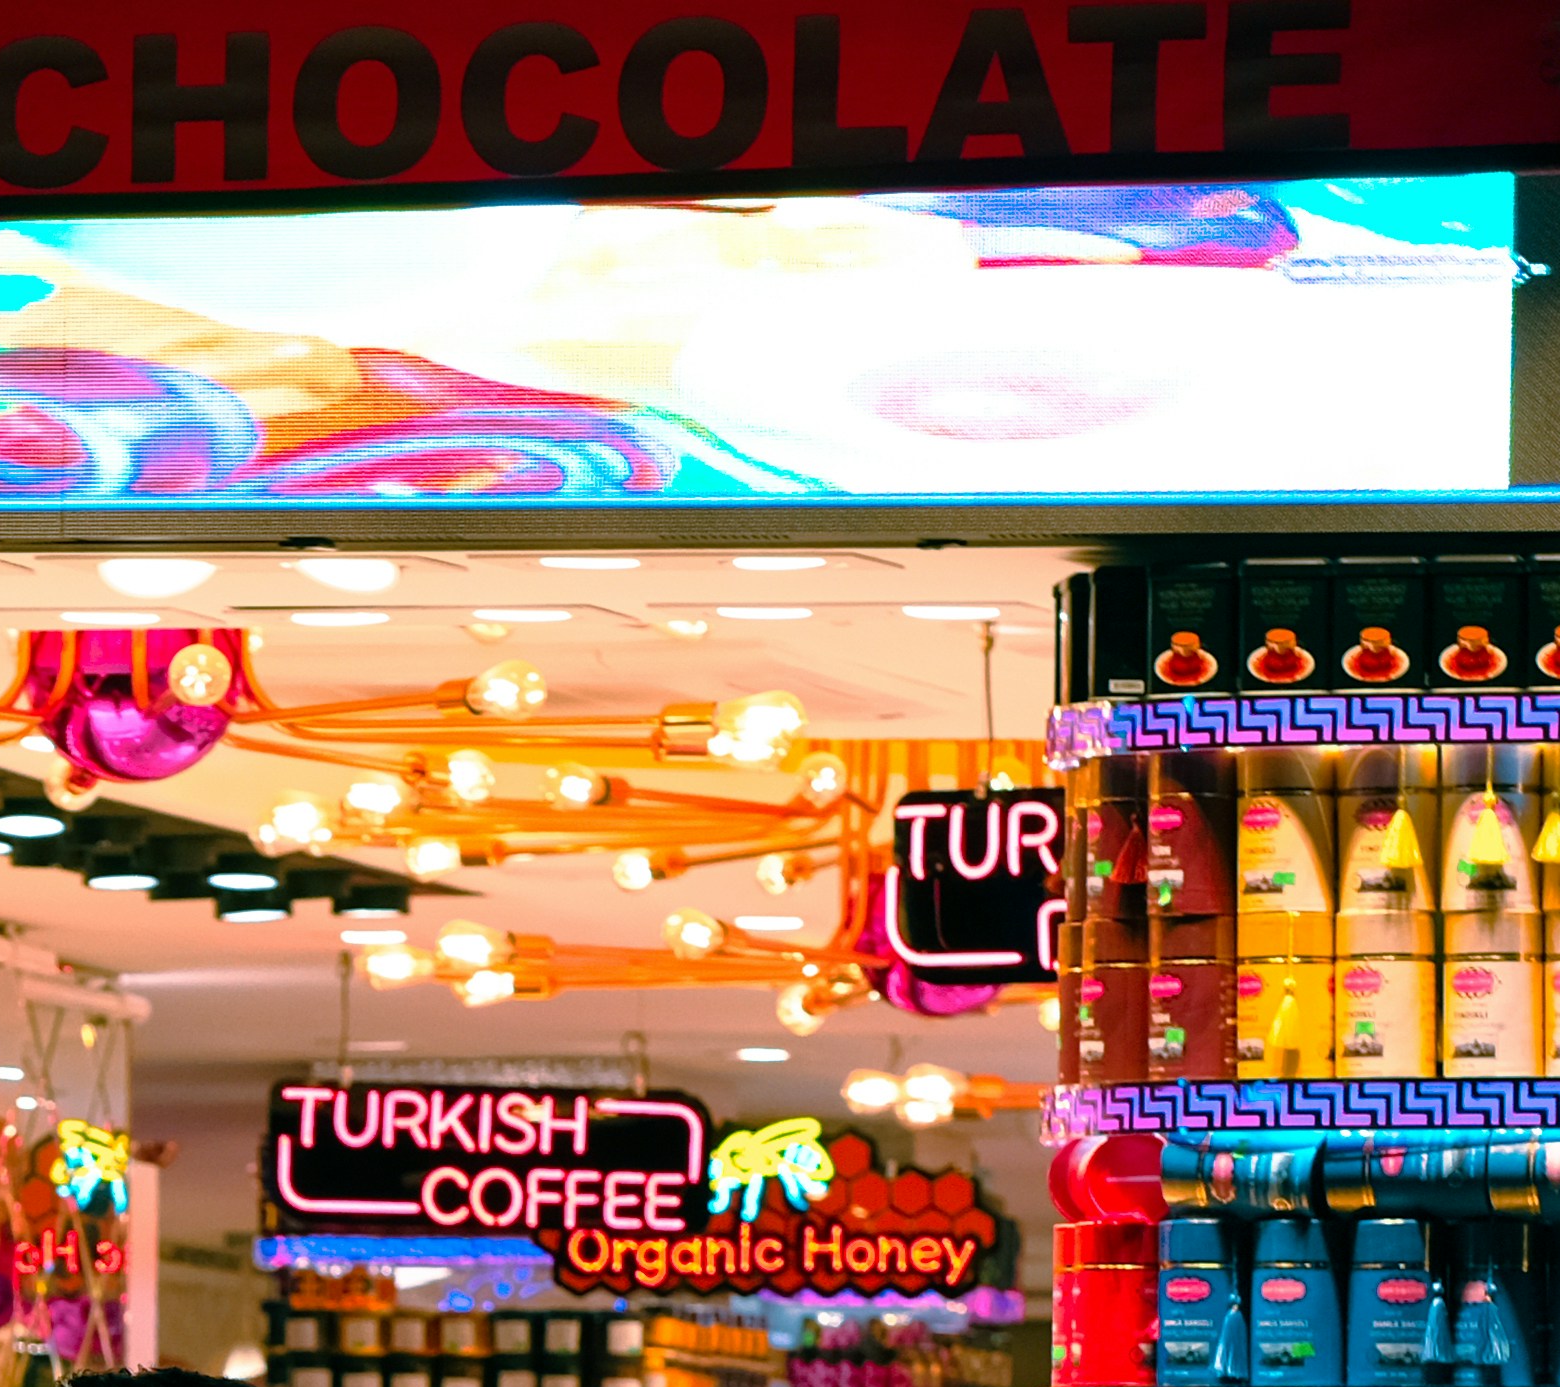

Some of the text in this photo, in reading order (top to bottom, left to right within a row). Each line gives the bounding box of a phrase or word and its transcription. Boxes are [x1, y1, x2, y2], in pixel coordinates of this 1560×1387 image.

[894, 800, 1060, 882] TUR
[281, 1085, 589, 1156] TURKISH
[420, 1165, 686, 1232] COFFEE
[566, 1222, 976, 1287] Organic Honey
